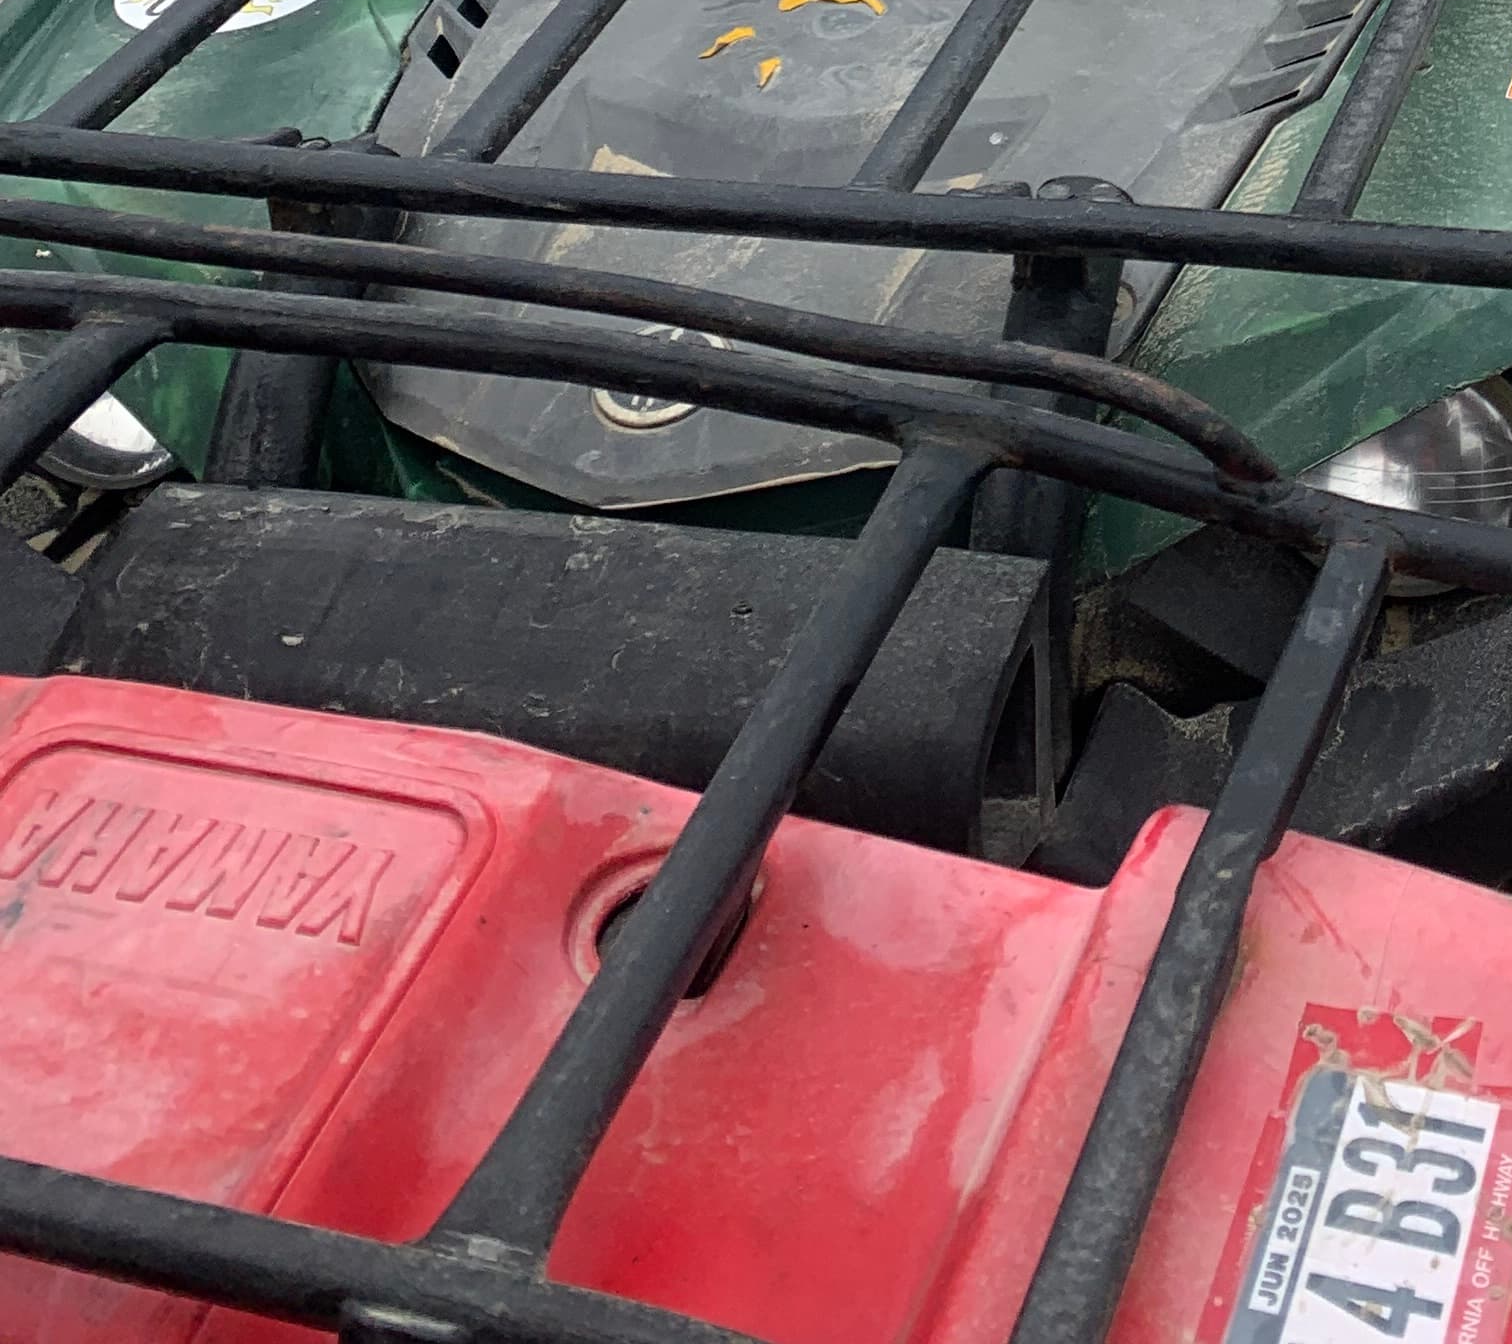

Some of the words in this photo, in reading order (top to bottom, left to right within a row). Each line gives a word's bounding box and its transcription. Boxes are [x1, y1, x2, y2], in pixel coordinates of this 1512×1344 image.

[0, 789, 395, 947] YAMAHA
[1256, 1252, 1288, 1307] JUN
[1276, 1175, 1313, 1240] 2025
[1471, 1246, 1495, 1289] OFF
